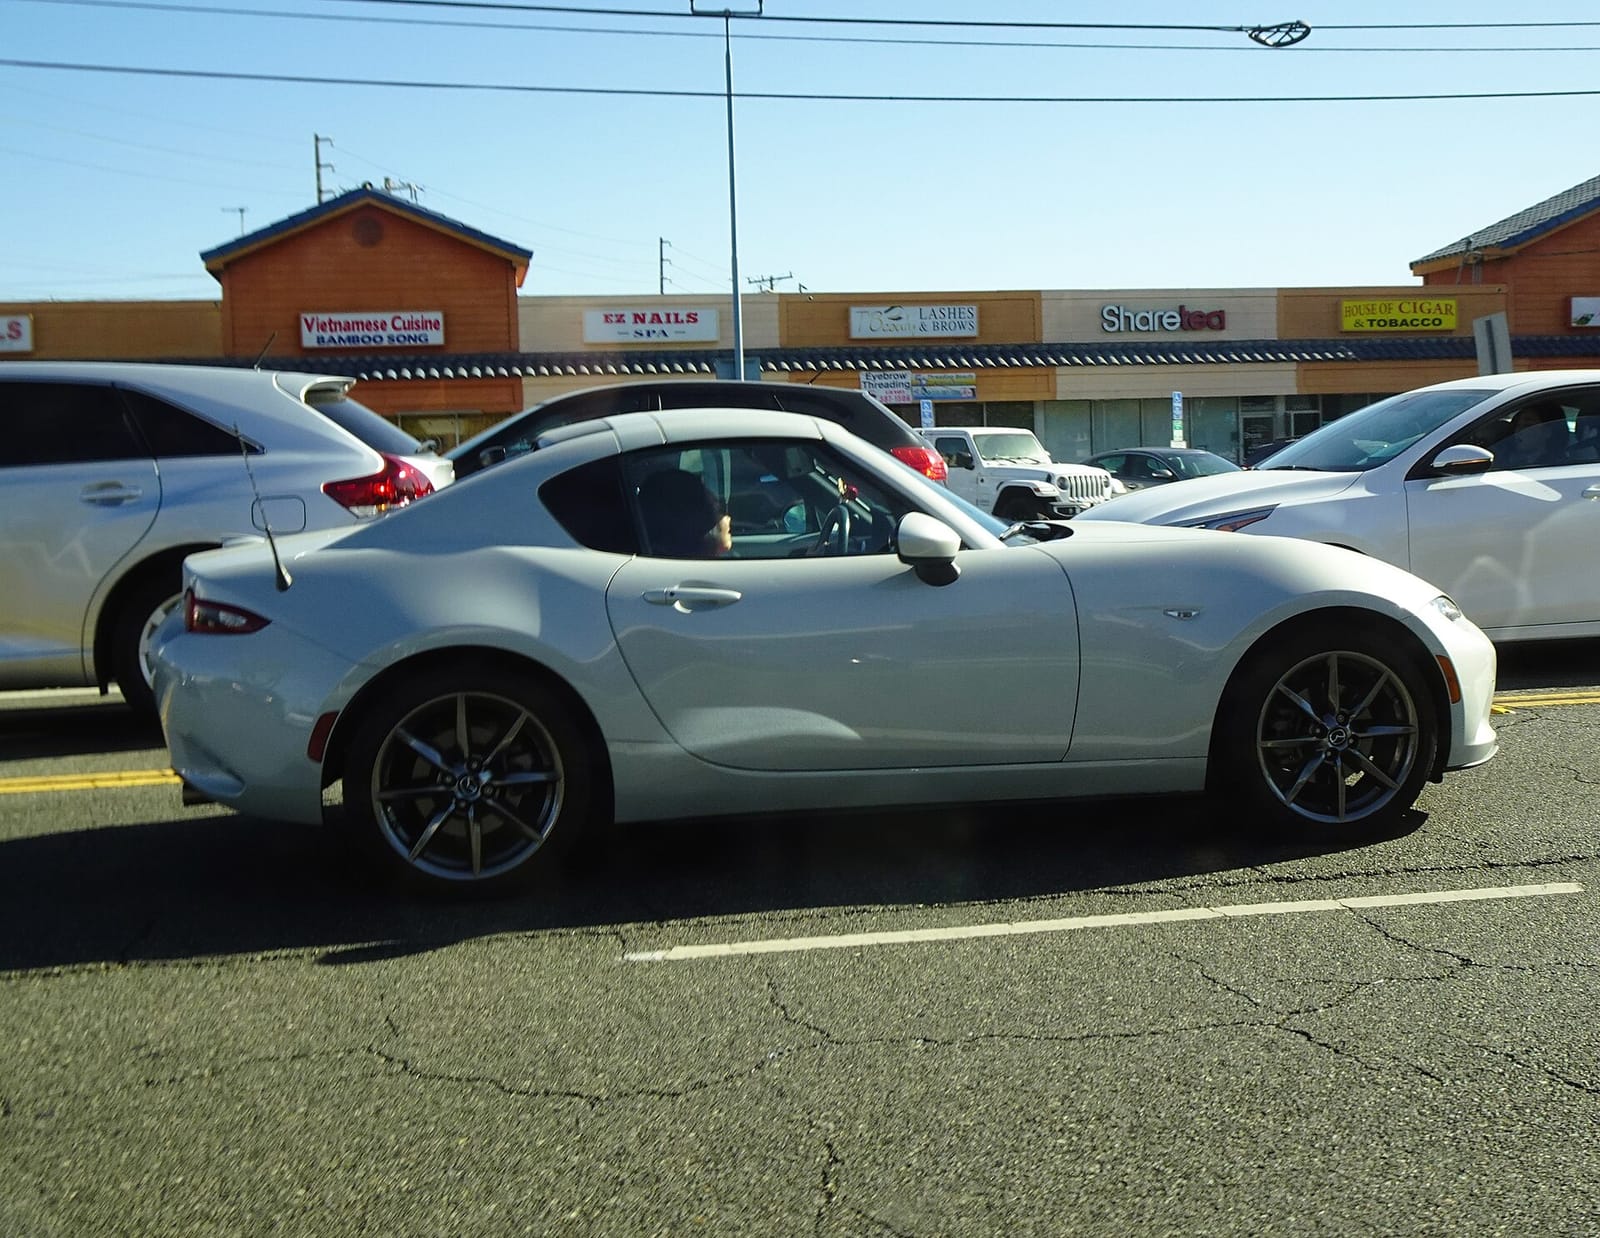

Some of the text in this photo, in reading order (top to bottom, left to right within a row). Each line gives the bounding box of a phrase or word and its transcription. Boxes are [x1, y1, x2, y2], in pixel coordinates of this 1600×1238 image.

[919, 307, 975, 320] LASHES
[1344, 301, 1455, 317] HOUSE OF CIGAR
[303, 314, 441, 333] Vietnamese Cuisine
[603, 311, 699, 324] EZ NAILS
[1101, 304, 1226, 332] Sharetea
[1353, 318, 1443, 328] & TOBACCO
[919, 320, 975, 332] & BROWS
[316, 332, 430, 345] BAMBOO SONG
[633, 329, 669, 338] SPA
[865, 371, 907, 383] Eyebrow
[863, 380, 911, 390] Threading
